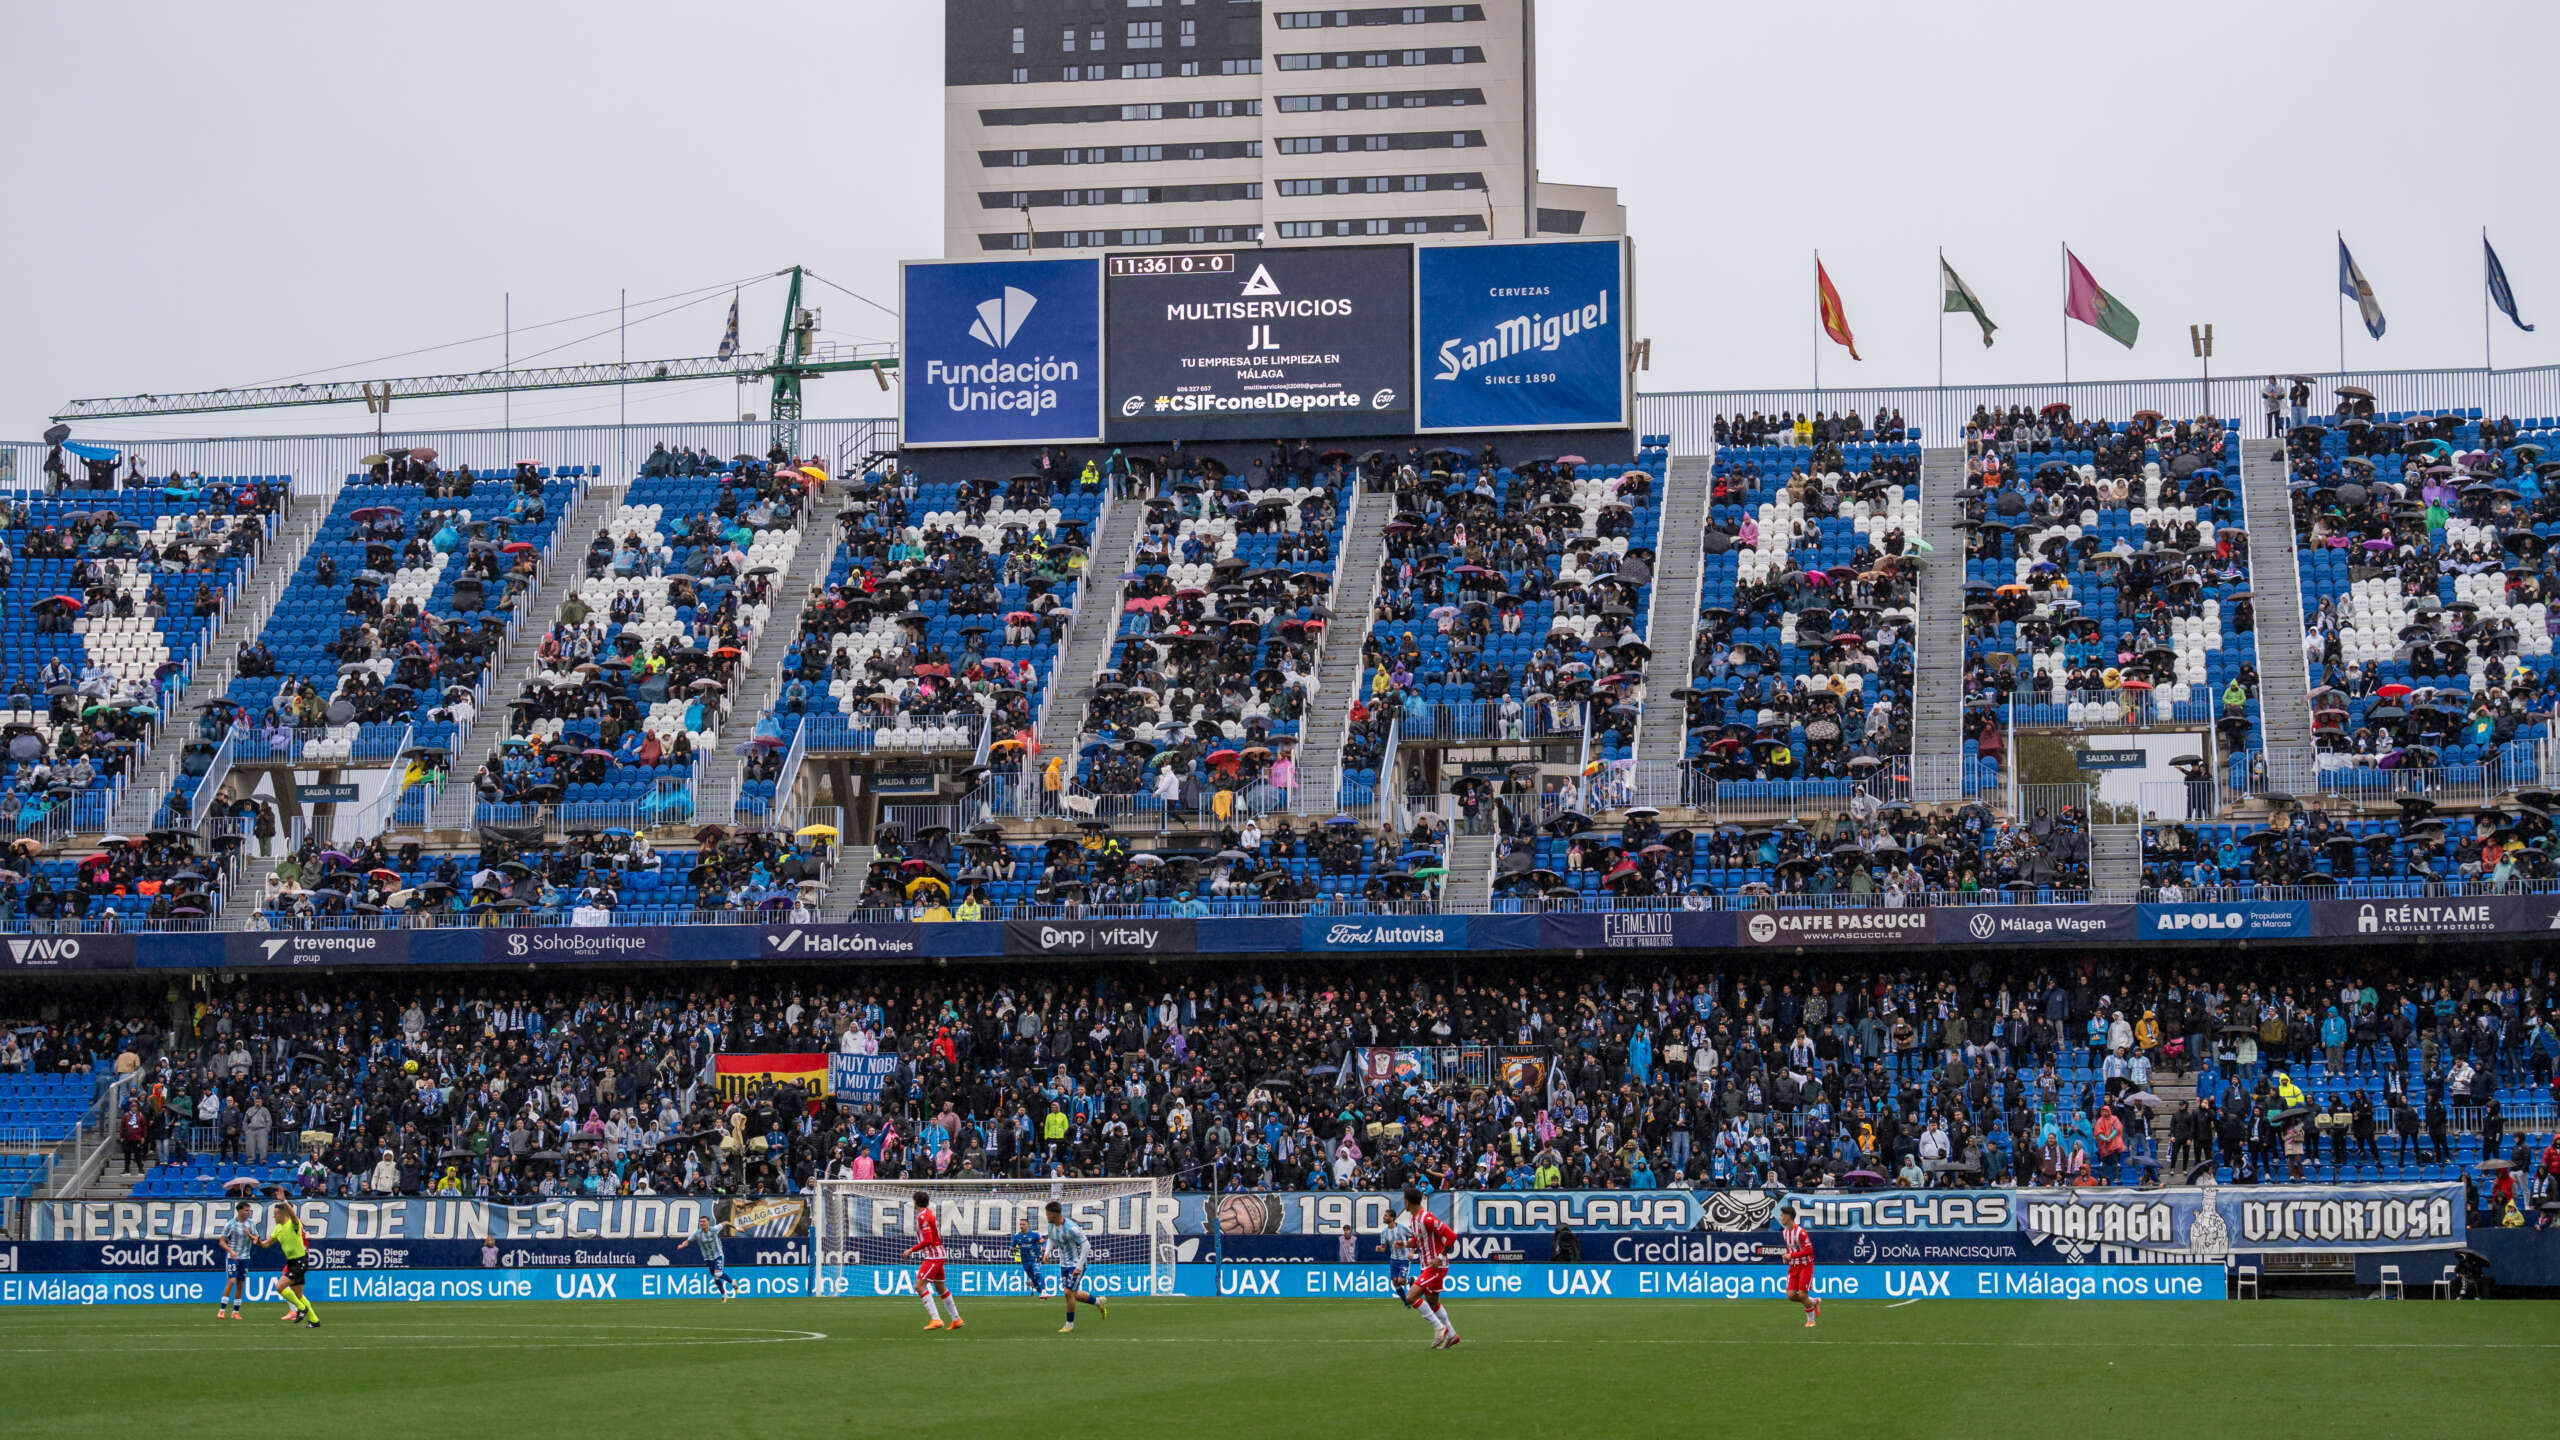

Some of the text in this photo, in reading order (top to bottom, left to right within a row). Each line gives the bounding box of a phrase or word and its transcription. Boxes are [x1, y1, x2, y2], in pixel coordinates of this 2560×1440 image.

[1115, 258, 1167, 273] 11:36
[1489, 286, 1551, 297] CERVEZAS
[1167, 299, 1352, 321] MULTISERVICIOS
[1247, 325, 1280, 350] JL
[927, 355, 1078, 385] Fundación
[1181, 354, 1340, 368] TU EMPRESA DE LIMPIEZA EN
[1237, 367, 1284, 380] MÁLAGA
[1485, 373, 1557, 385] SINCE 1890
[949, 384, 1057, 416] Unicaja
[1154, 391, 1361, 412] #CSIFconelDeporte
[2085, 753, 2138, 763] SALIDA EXIT
[1471, 766, 1499, 775] SALIDA
[877, 777, 927, 786] SALIDA EXIT
[303, 788, 352, 796] SALIDA EXIT
[1779, 913, 1926, 930] CAFFE PASCUCCI
[2157, 912, 2292, 931] APOLO Propulsora
[2385, 904, 2490, 923] RÉNTAME
[1604, 913, 1672, 943] FERMENTO
[2001, 917, 2106, 933] Málaga Wagen
[2251, 920, 2292, 928] de Marcas
[2382, 923, 2495, 932] ALQUILER PROTEGIDO
[804, 933, 914, 953] Halcón viajes
[1100, 928, 1159, 949] vitaly
[1326, 924, 1444, 944] Ford Autovisa
[293, 936, 377, 952] trevenque
[533, 933, 646, 954] SohoBoutique
[293, 954, 321, 964] group
[837, 1054, 864, 1072] MUY
[846, 1073, 871, 1089] MUY
[346, 1201, 407, 1240] DE
[423, 1200, 490, 1240] UN
[506, 1200, 701, 1240] ESCUDO
[1070, 1197, 1180, 1236] SUR
[1477, 1199, 1687, 1226] MALAKA
[1791, 1197, 2008, 1227] HINCHAS
[2028, 1190, 2173, 1243] MÁLAGA
[101, 1244, 215, 1266] Sould Park
[326, 1248, 351, 1258] Diego
[384, 1248, 409, 1258] Diego
[517, 1249, 571, 1267] Pinturas
[1881, 1244, 2017, 1259] DOÑA FRANCISQUITA
[3, 1281, 22, 1301] El
[28, 1278, 108, 1305] Málaga
[114, 1285, 155, 1300] nos
[160, 1283, 203, 1299] une
[244, 1276, 286, 1301] UA
[329, 1277, 347, 1297] El
[353, 1275, 436, 1301] Málaga
[441, 1282, 482, 1297] nos
[488, 1280, 532, 1297] une
[556, 1273, 617, 1298] UAX
[642, 1275, 661, 1295] El
[667, 1272, 751, 1299] Málaga
[757, 1278, 799, 1294] nos
[961, 1271, 982, 1292] El
[1081, 1275, 1121, 1292] nos
[1219, 1269, 1281, 1295] UAX
[1306, 1271, 1327, 1293] El
[1476, 1275, 1522, 1292] une
[1548, 1269, 1612, 1295] UAX
[1639, 1271, 1659, 1293] El
[1666, 1270, 1757, 1298] Málaga
[1812, 1277, 1859, 1294] une
[1885, 1271, 1950, 1297] UAX
[1978, 1272, 1999, 1294] El
[2005, 1272, 2096, 1300] Málaga
[2102, 1276, 2148, 1294] nos
[2154, 1276, 2202, 1294] une
